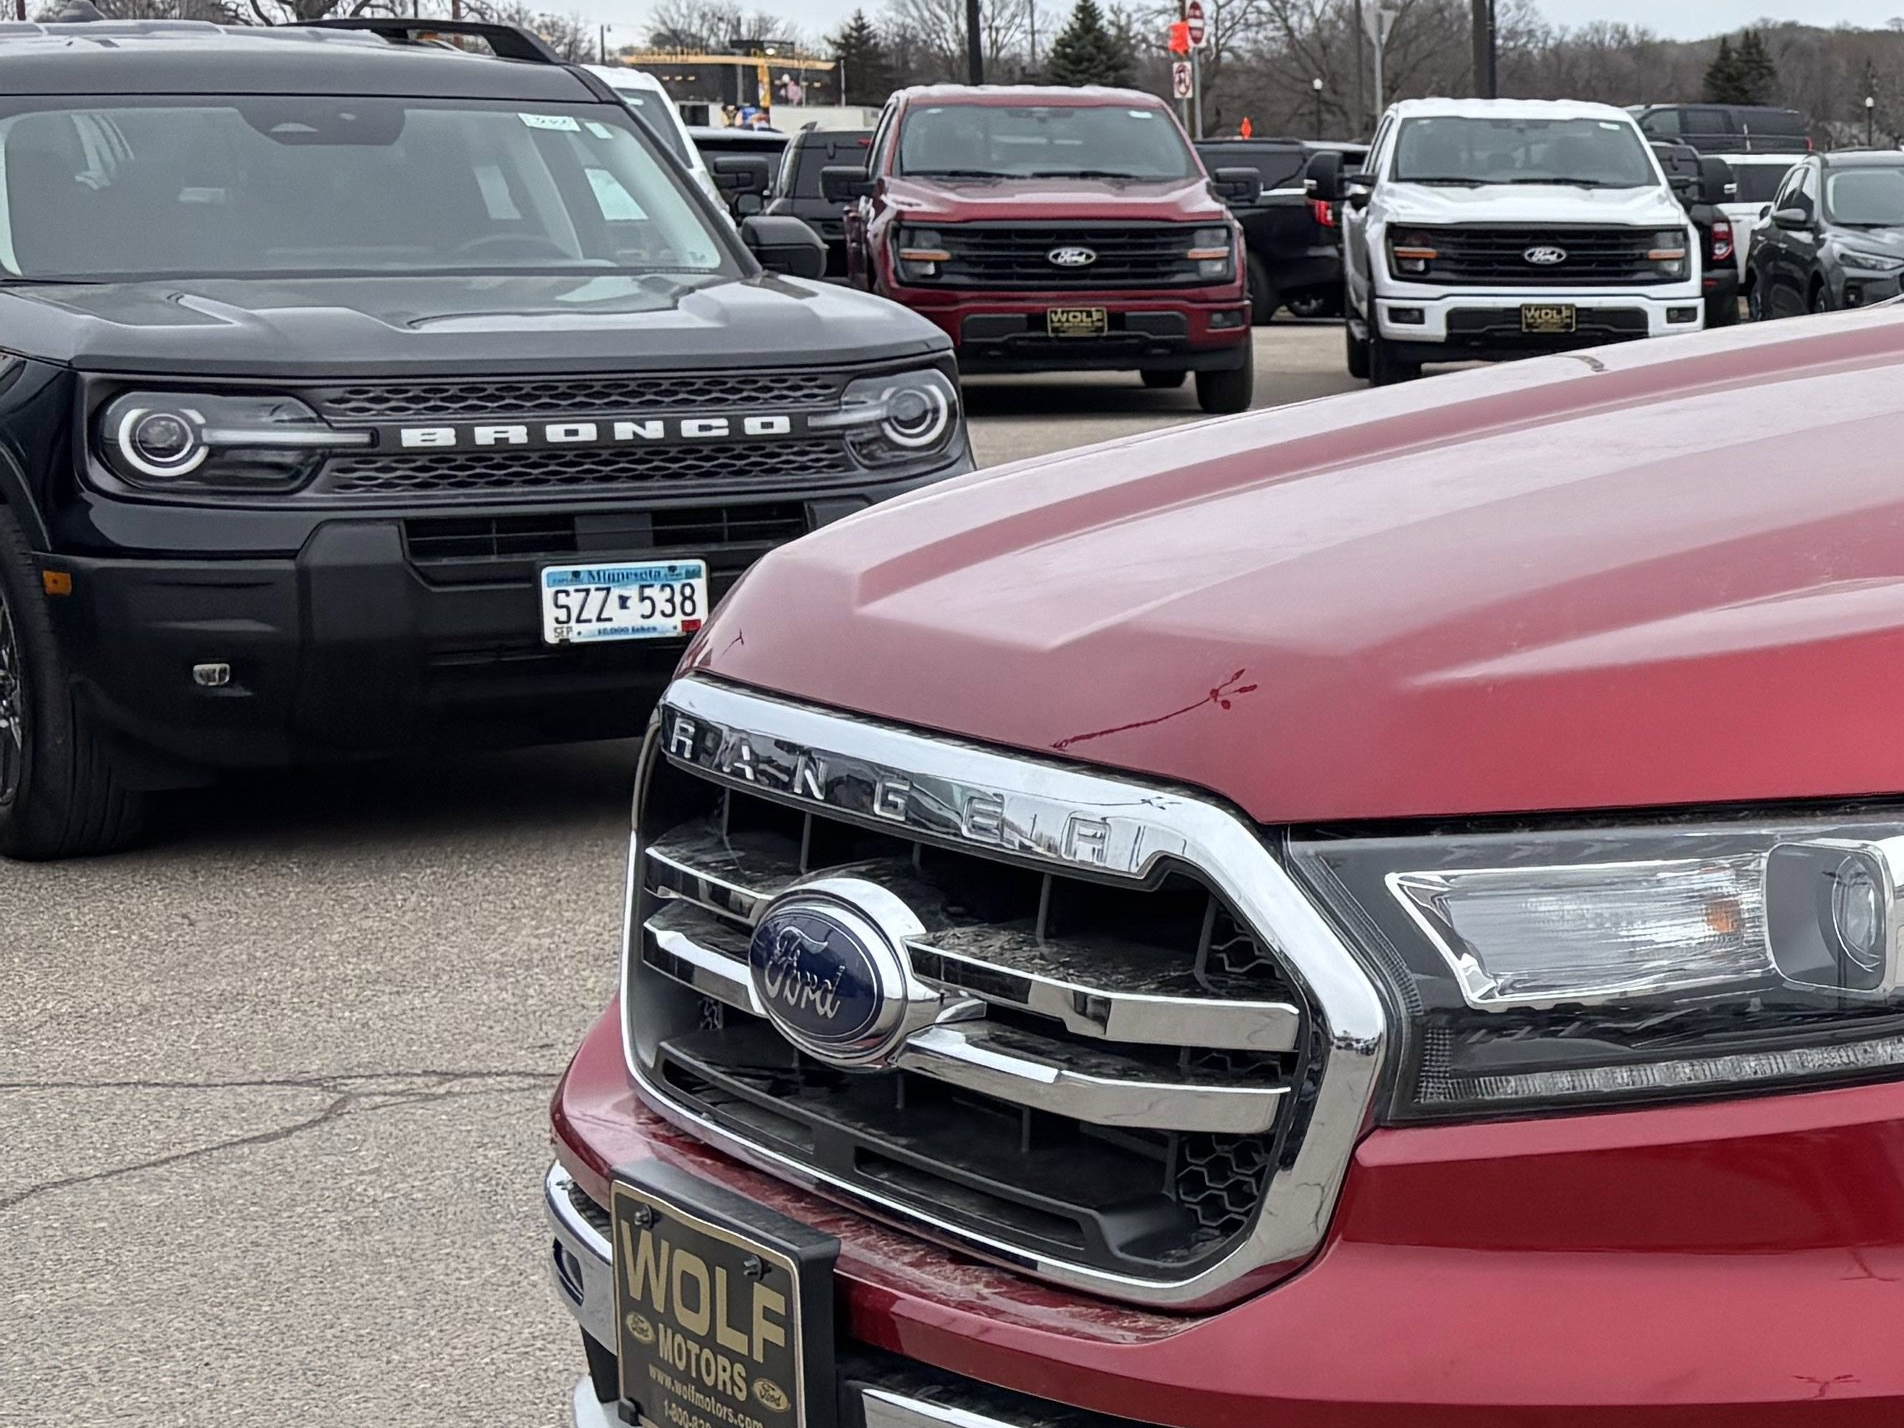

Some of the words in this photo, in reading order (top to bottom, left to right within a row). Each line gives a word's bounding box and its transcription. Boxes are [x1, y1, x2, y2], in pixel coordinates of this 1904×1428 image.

[1051, 310, 1104, 323] WOLF
[400, 415, 791, 448] BRONCO
[587, 568, 662, 585] Minnesota
[553, 585, 614, 625] SZZ
[638, 581, 697, 621] 538
[553, 626, 573, 639] SEP
[668, 715, 1112, 865] RANGER
[764, 924, 846, 1019] Ford
[620, 1219, 786, 1364] WOLF
[658, 1323, 747, 1402] MOTORS
